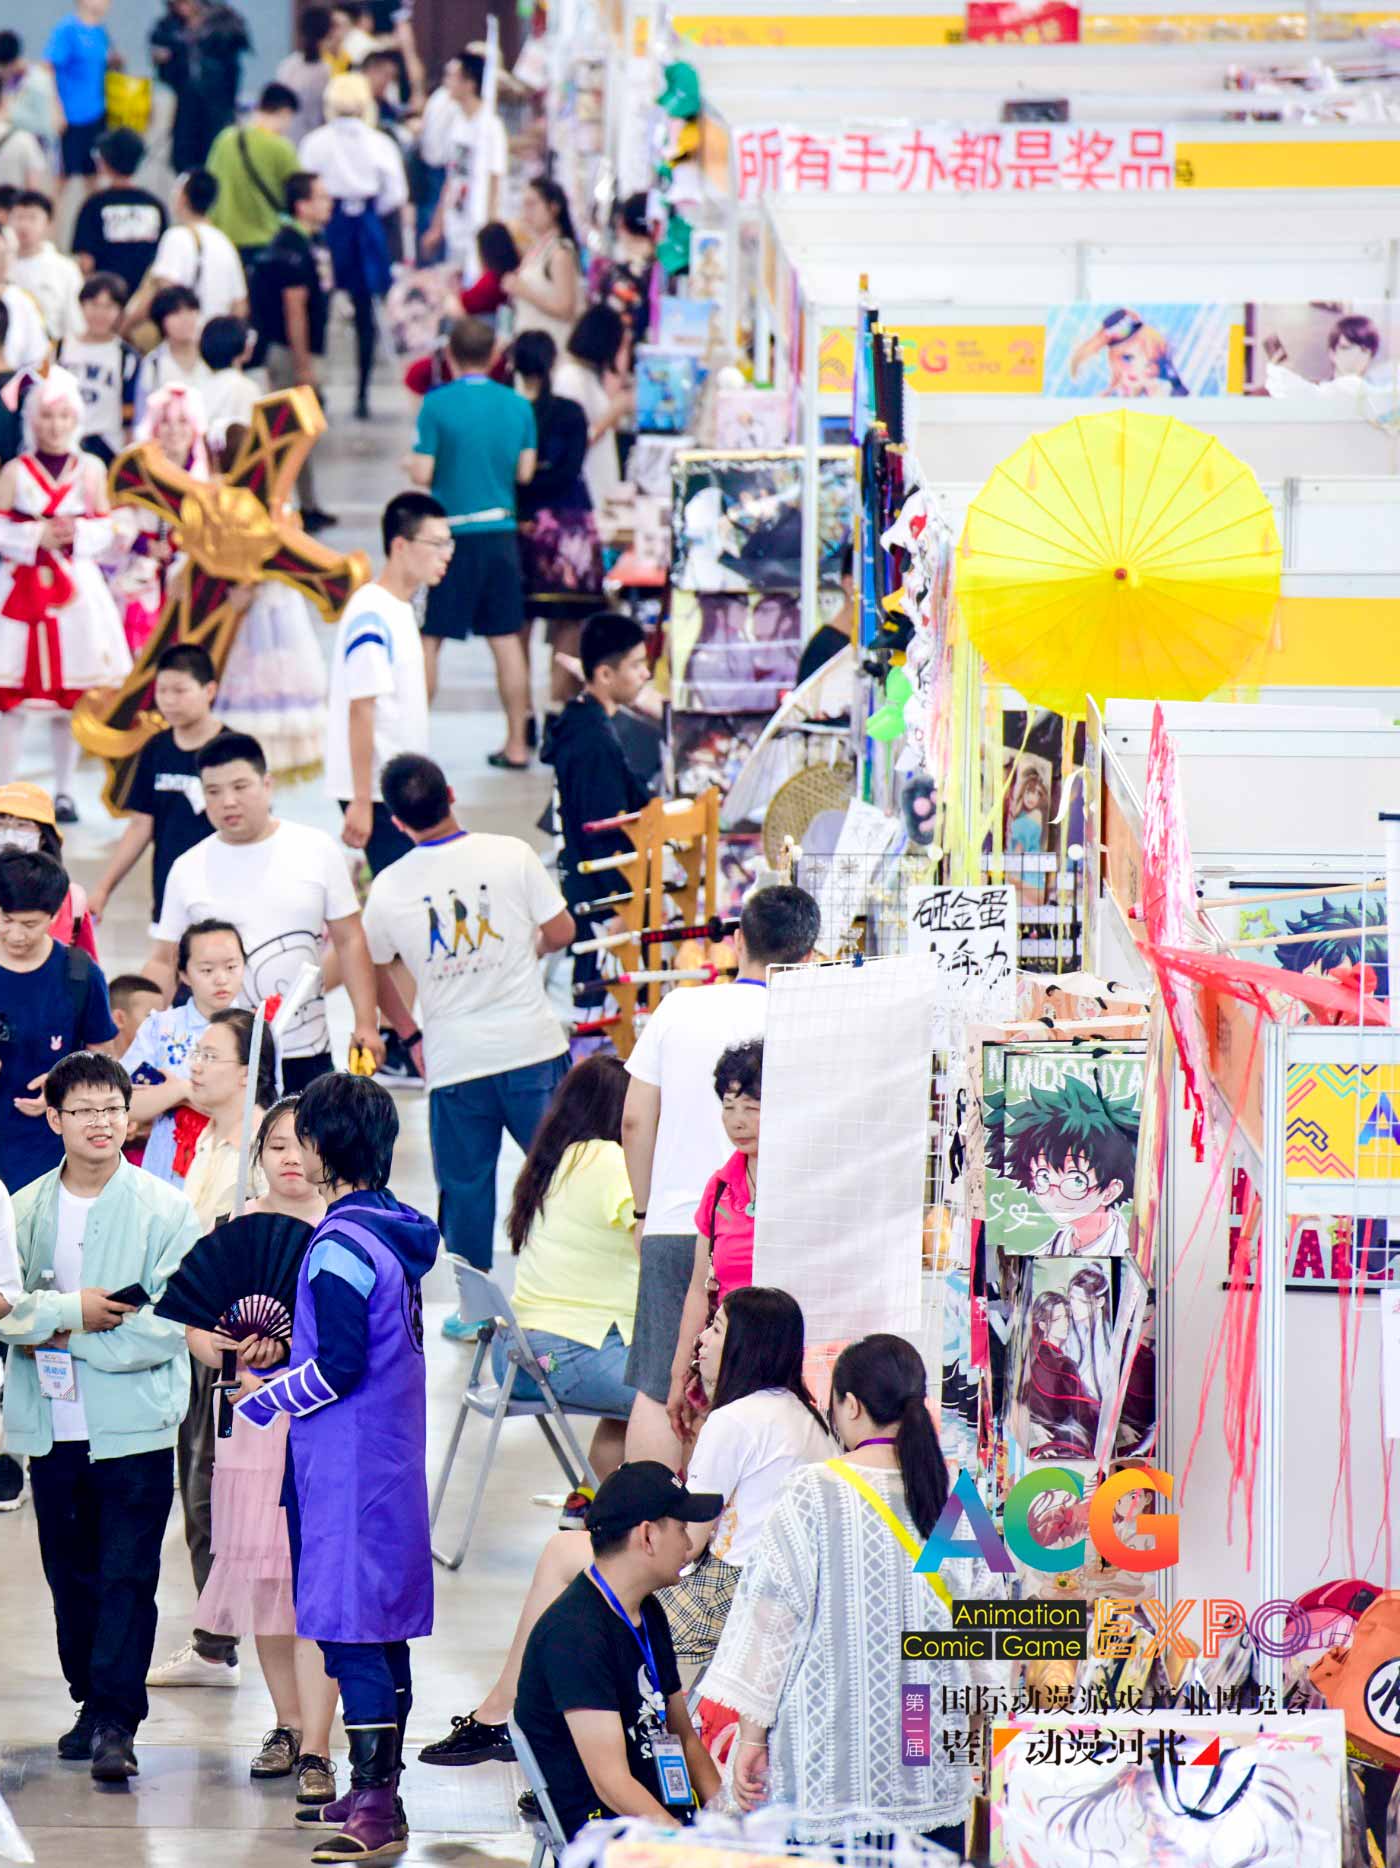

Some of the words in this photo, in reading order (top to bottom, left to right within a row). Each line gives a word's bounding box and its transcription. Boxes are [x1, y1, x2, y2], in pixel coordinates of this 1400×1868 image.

[737, 129, 1171, 198] 所有手办都是奖品
[912, 889, 1008, 932] 砸金蛋
